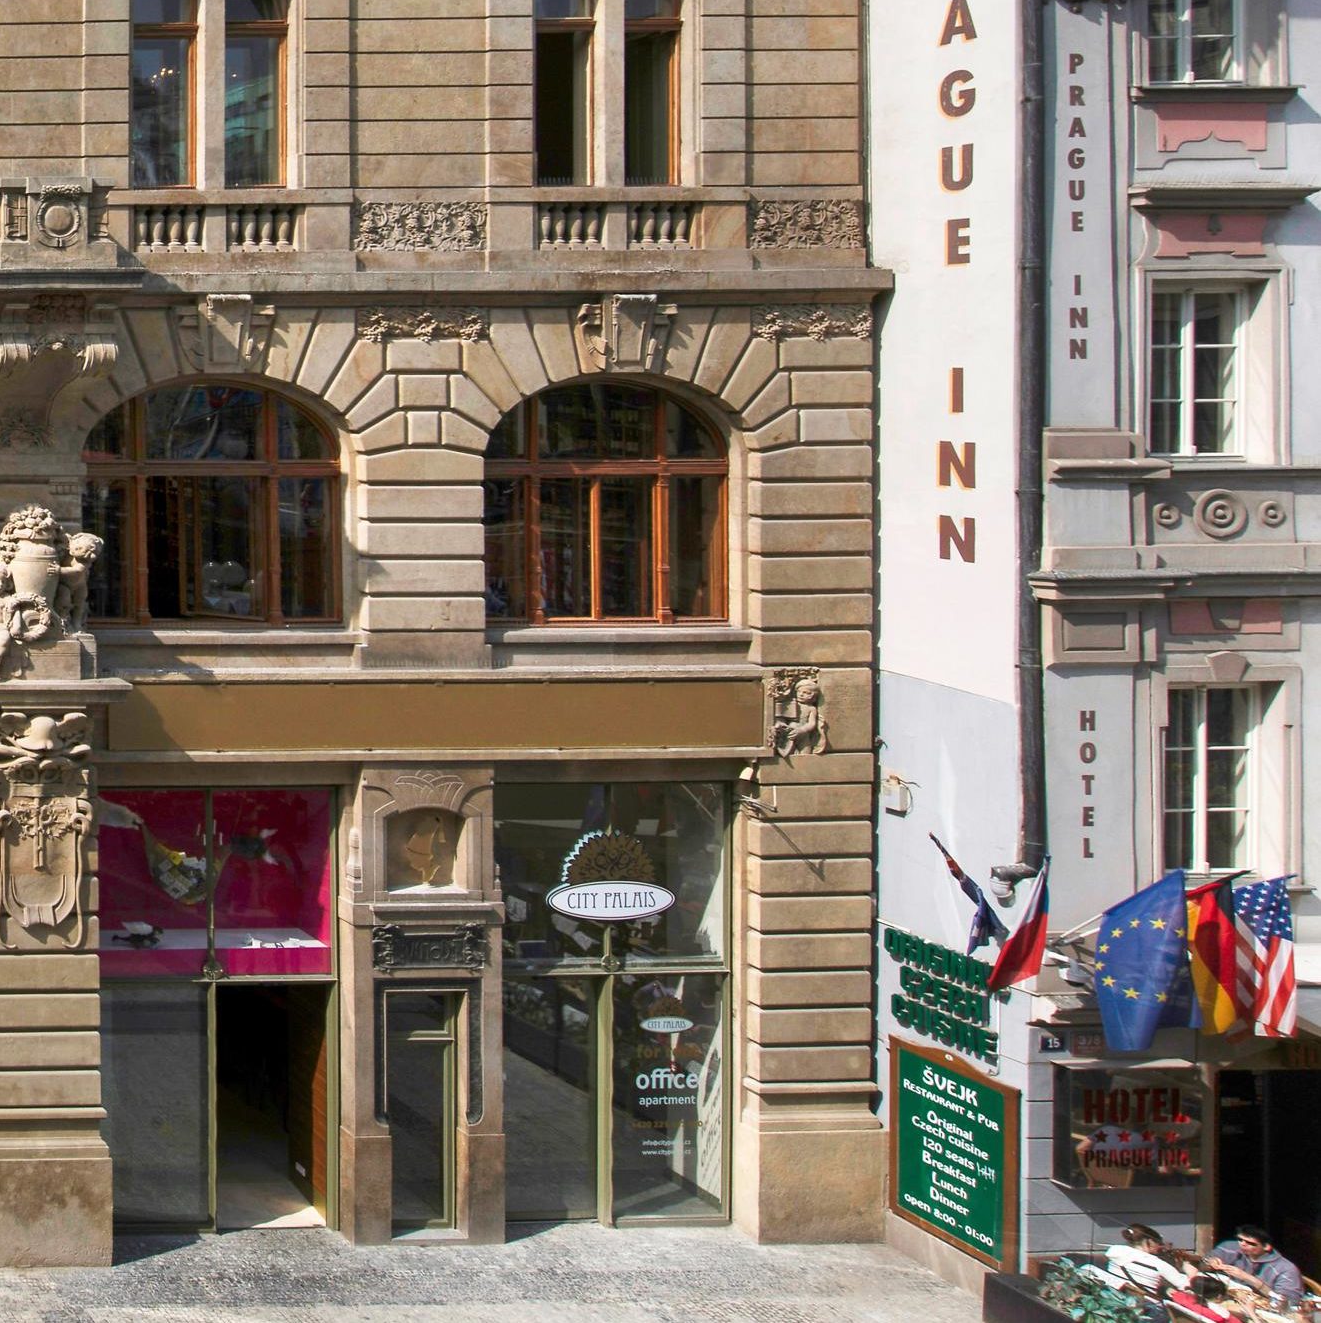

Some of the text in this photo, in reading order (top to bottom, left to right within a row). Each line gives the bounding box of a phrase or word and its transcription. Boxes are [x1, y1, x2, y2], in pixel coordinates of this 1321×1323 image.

[1068, 53, 1087, 233] PRAGUE
[1069, 274, 1088, 361] INN
[937, 366, 977, 565] INN
[1080, 710, 1097, 859] HOTEL
[567, 891, 656, 908] CITY PALAIS
[884, 928, 1004, 1000] ORIGINA
[900, 965, 990, 1026] CZECH
[891, 994, 998, 1066] CUISINE
[1047, 1038, 1061, 1048] 15
[635, 1067, 699, 1090] office
[922, 1065, 978, 1108] ŠVEJK
[639, 1095, 696, 1108] apartment
[903, 1078, 966, 1116] RESTAURANT
[966, 1110, 976, 1121] &
[1083, 1087, 1191, 1125] HOTEL
[911, 1115, 989, 1161] Czech cuisine
[926, 1110, 974, 1142] Original
[922, 1149, 976, 1188] Breakfast
[923, 1136, 975, 1171] 120 seats
[1084, 1149, 1153, 1169] PRAGUE
[929, 1186, 970, 1216] Dinner
[931, 1171, 968, 1200] Lunch
[904, 1193, 931, 1213] open
[933, 1208, 956, 1227] 8:00
[964, 1225, 994, 1247] 01:00
